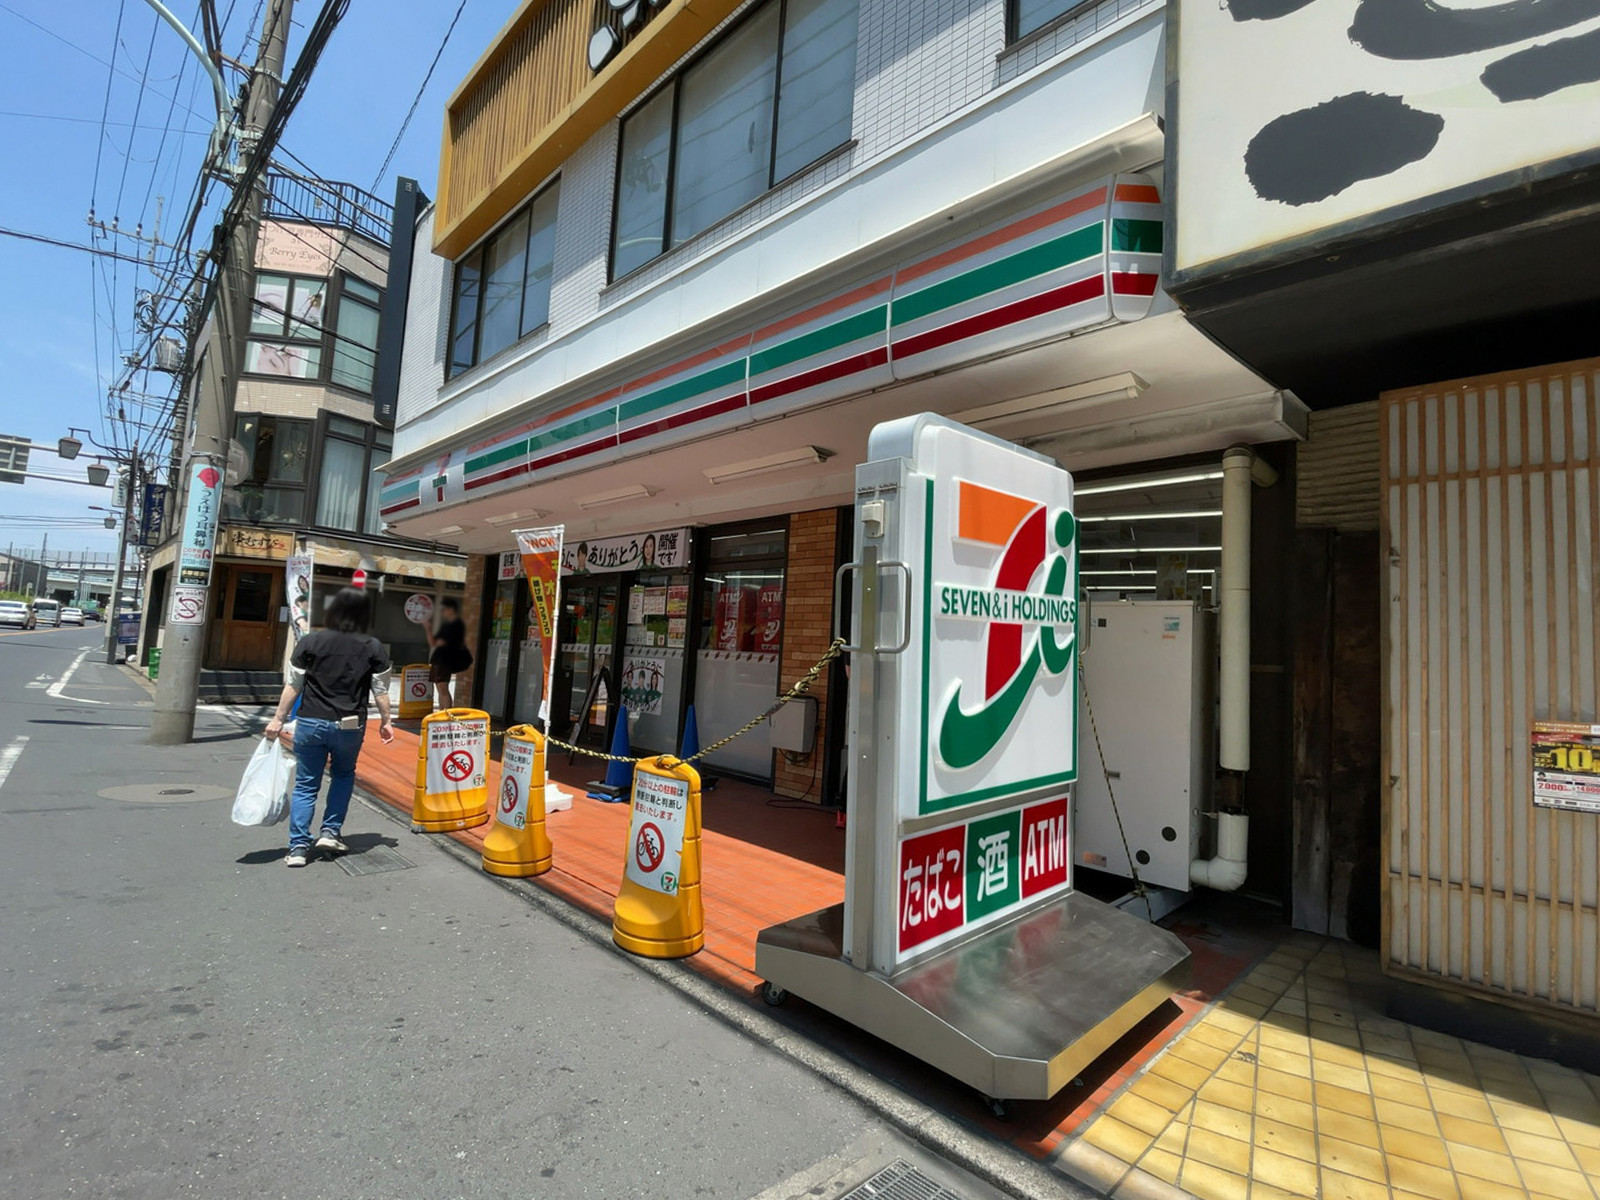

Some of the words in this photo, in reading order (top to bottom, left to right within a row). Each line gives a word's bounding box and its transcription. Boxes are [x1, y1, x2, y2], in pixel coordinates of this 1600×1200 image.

[269, 247, 297, 260] Berry
[299, 250, 321, 262] Eyes
[657, 533, 679, 551] 開催
[588, 540, 638, 567] ありがとう
[761, 591, 782, 602] ATM
[1011, 594, 1076, 623] HOLDINGS
[902, 847, 961, 932] たばこ
[977, 830, 1011, 902] 酒
[1024, 815, 1065, 881] ATM
